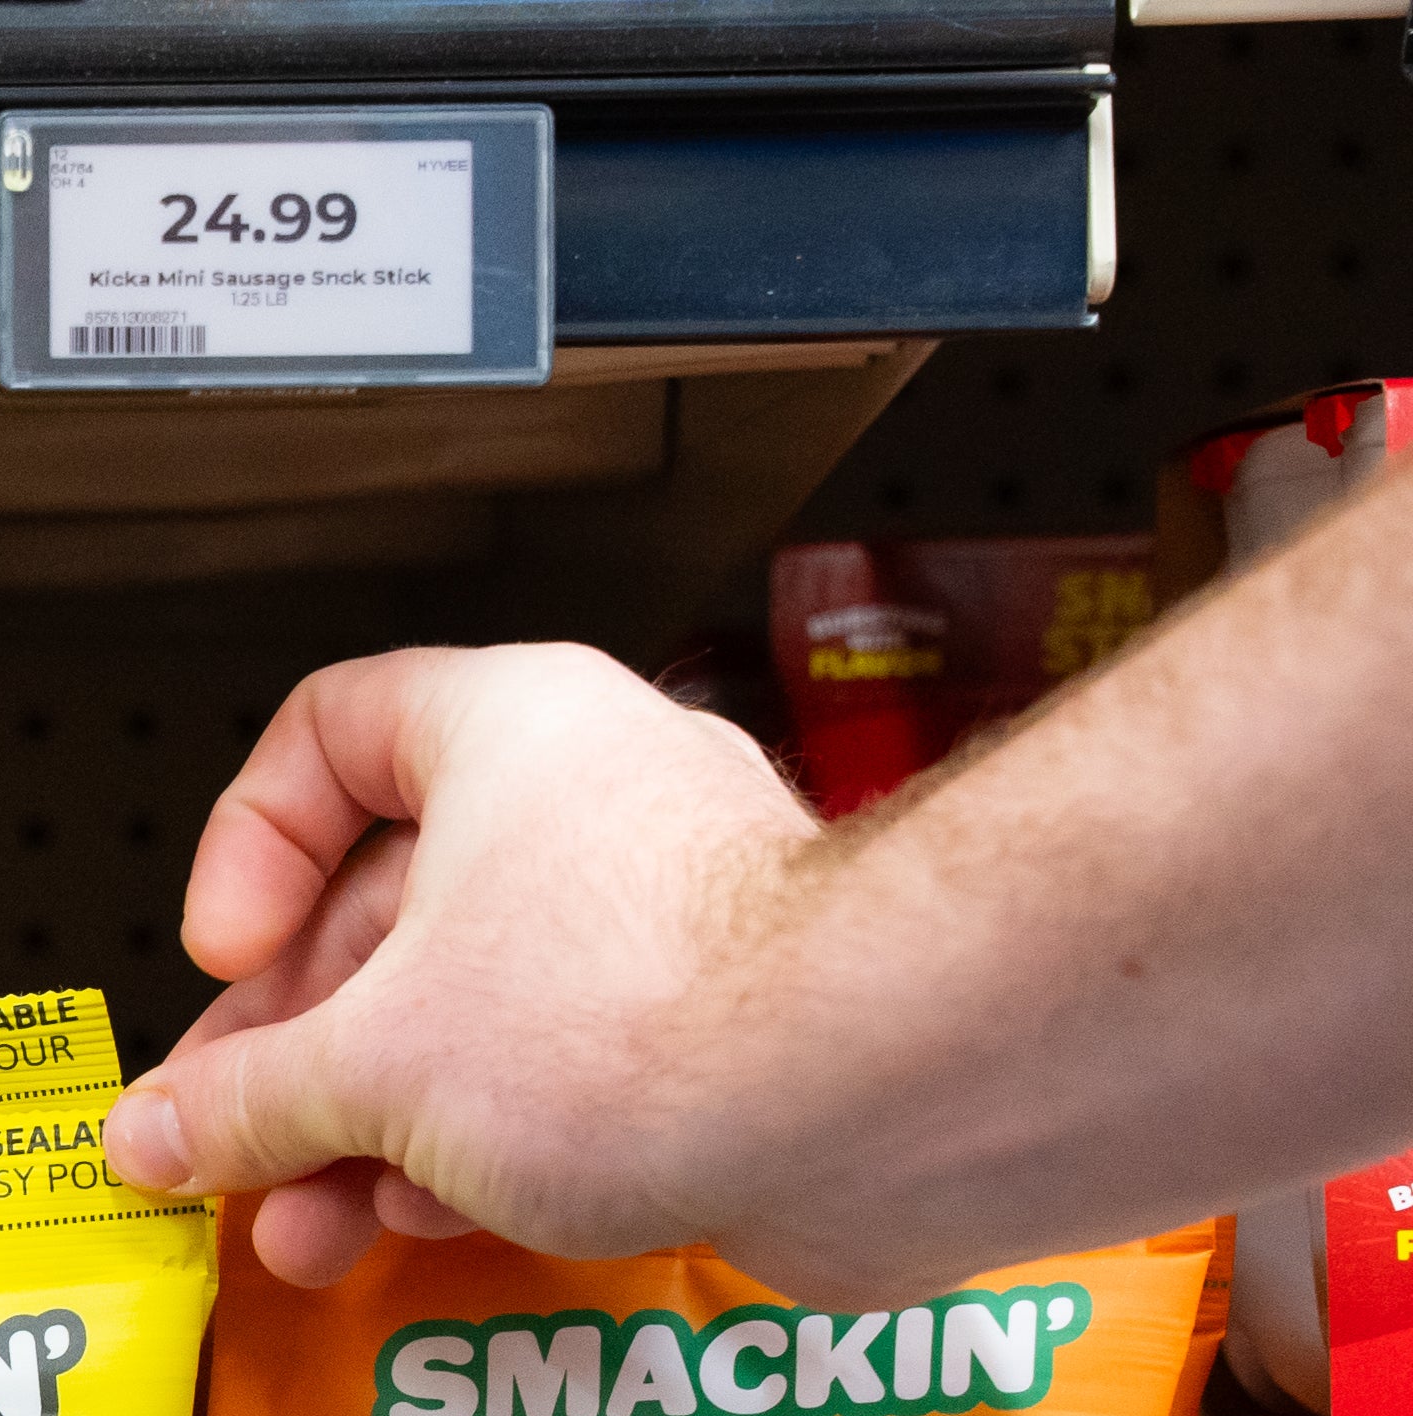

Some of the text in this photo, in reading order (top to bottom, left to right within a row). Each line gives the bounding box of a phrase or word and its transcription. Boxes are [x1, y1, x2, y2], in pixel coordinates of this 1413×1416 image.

[76, 177, 86, 188] 4
[160, 192, 358, 244] 24.99
[88, 268, 432, 290] Kicka Mini Sausage Snck Stick
[266, 292, 288, 306] LB
[48, 1158, 124, 1194] POU
